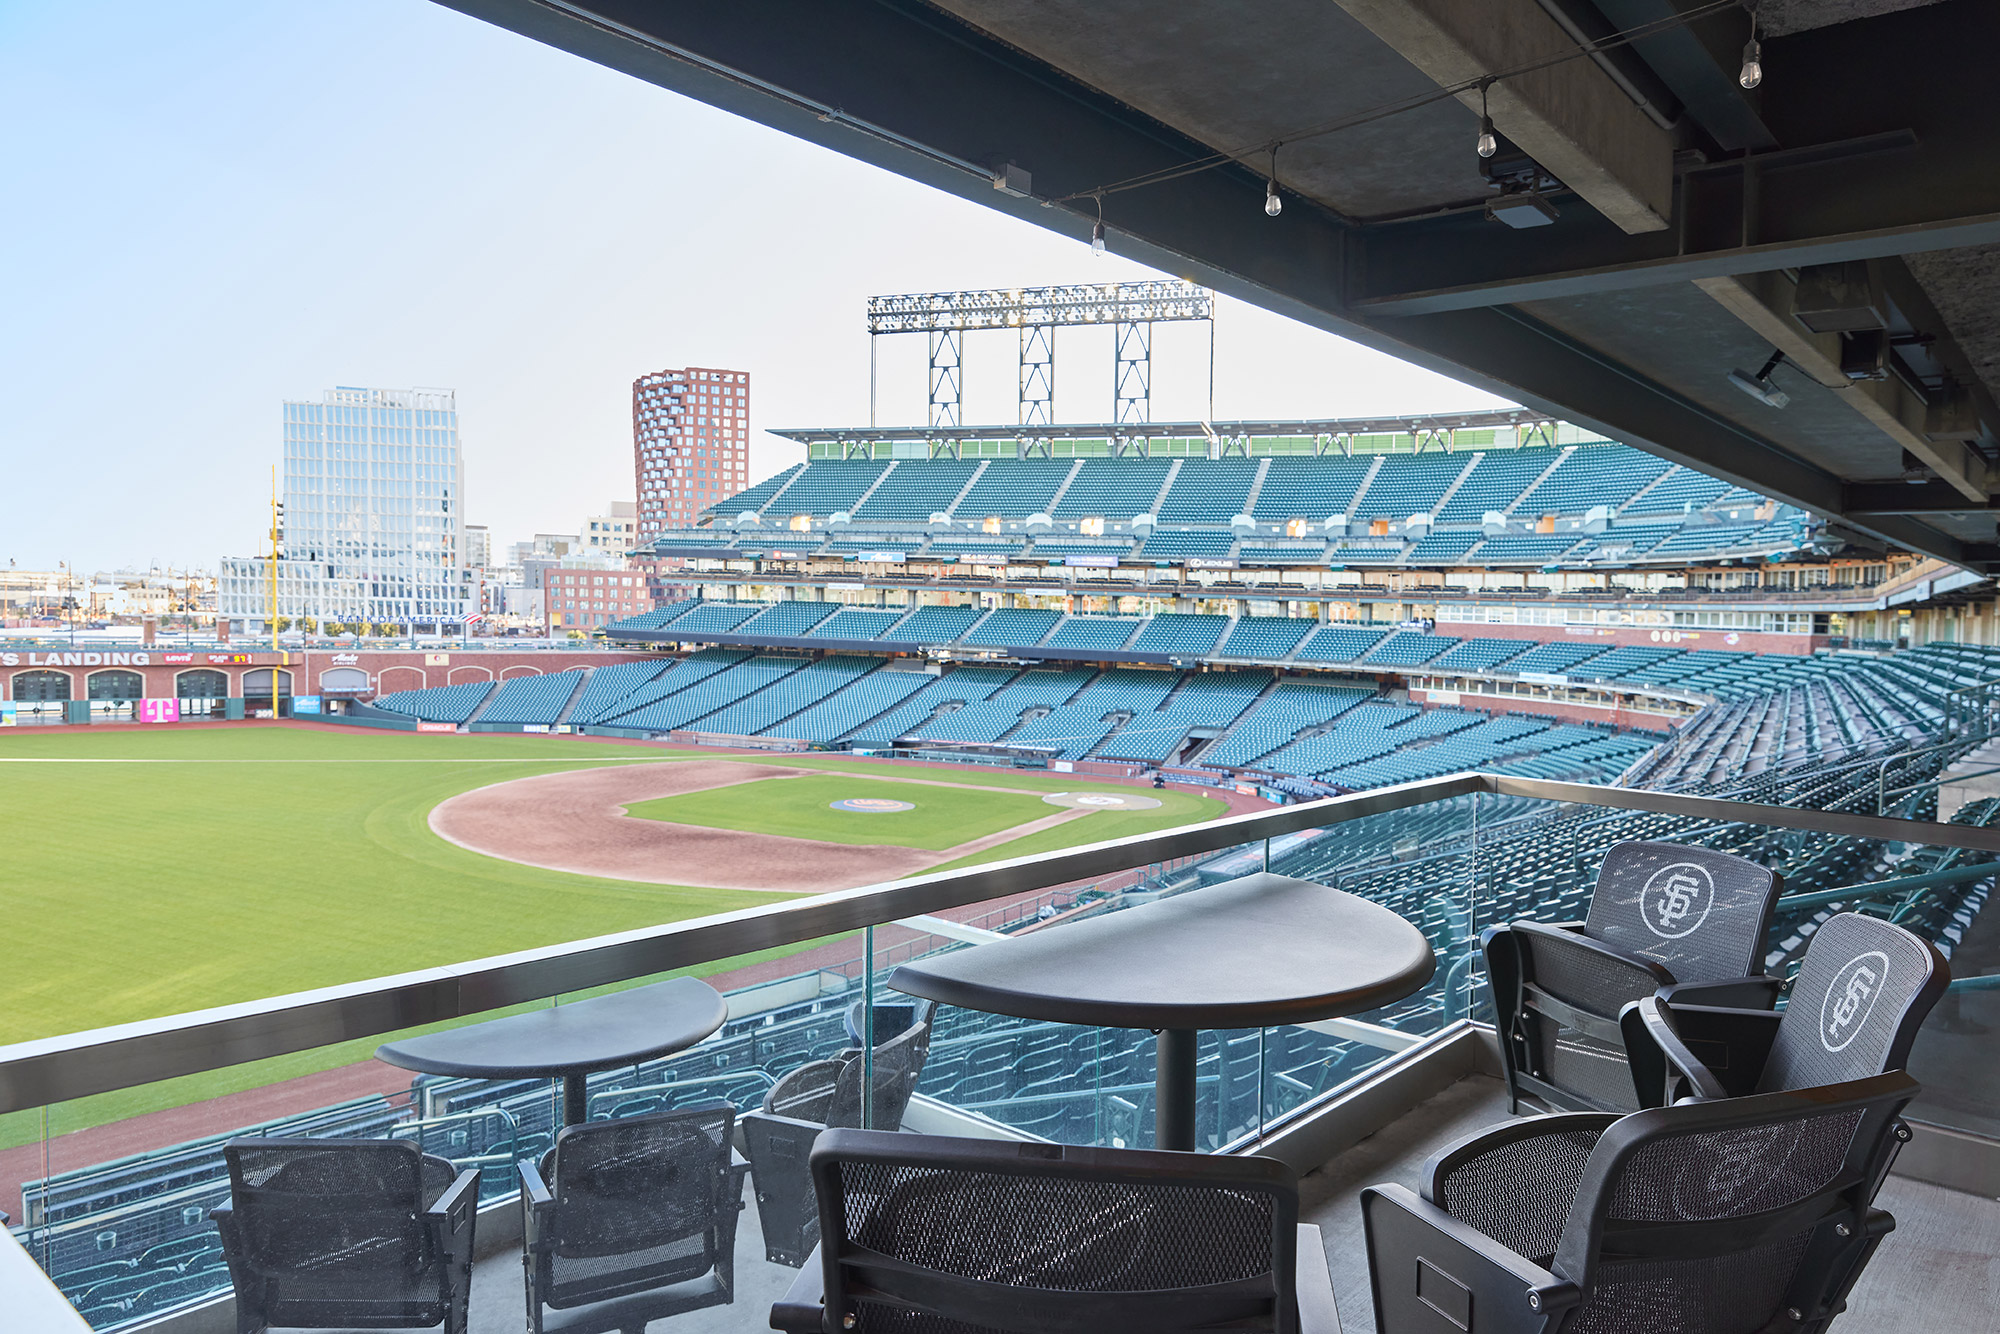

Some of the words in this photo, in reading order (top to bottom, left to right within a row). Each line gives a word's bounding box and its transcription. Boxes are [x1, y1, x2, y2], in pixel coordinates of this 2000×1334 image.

[1202, 560, 1233, 568] LEXUS
[338, 614, 373, 623] BANK
[378, 615, 393, 624] OF
[398, 616, 455, 625] AMERICA
[29, 652, 150, 666] LANDING
